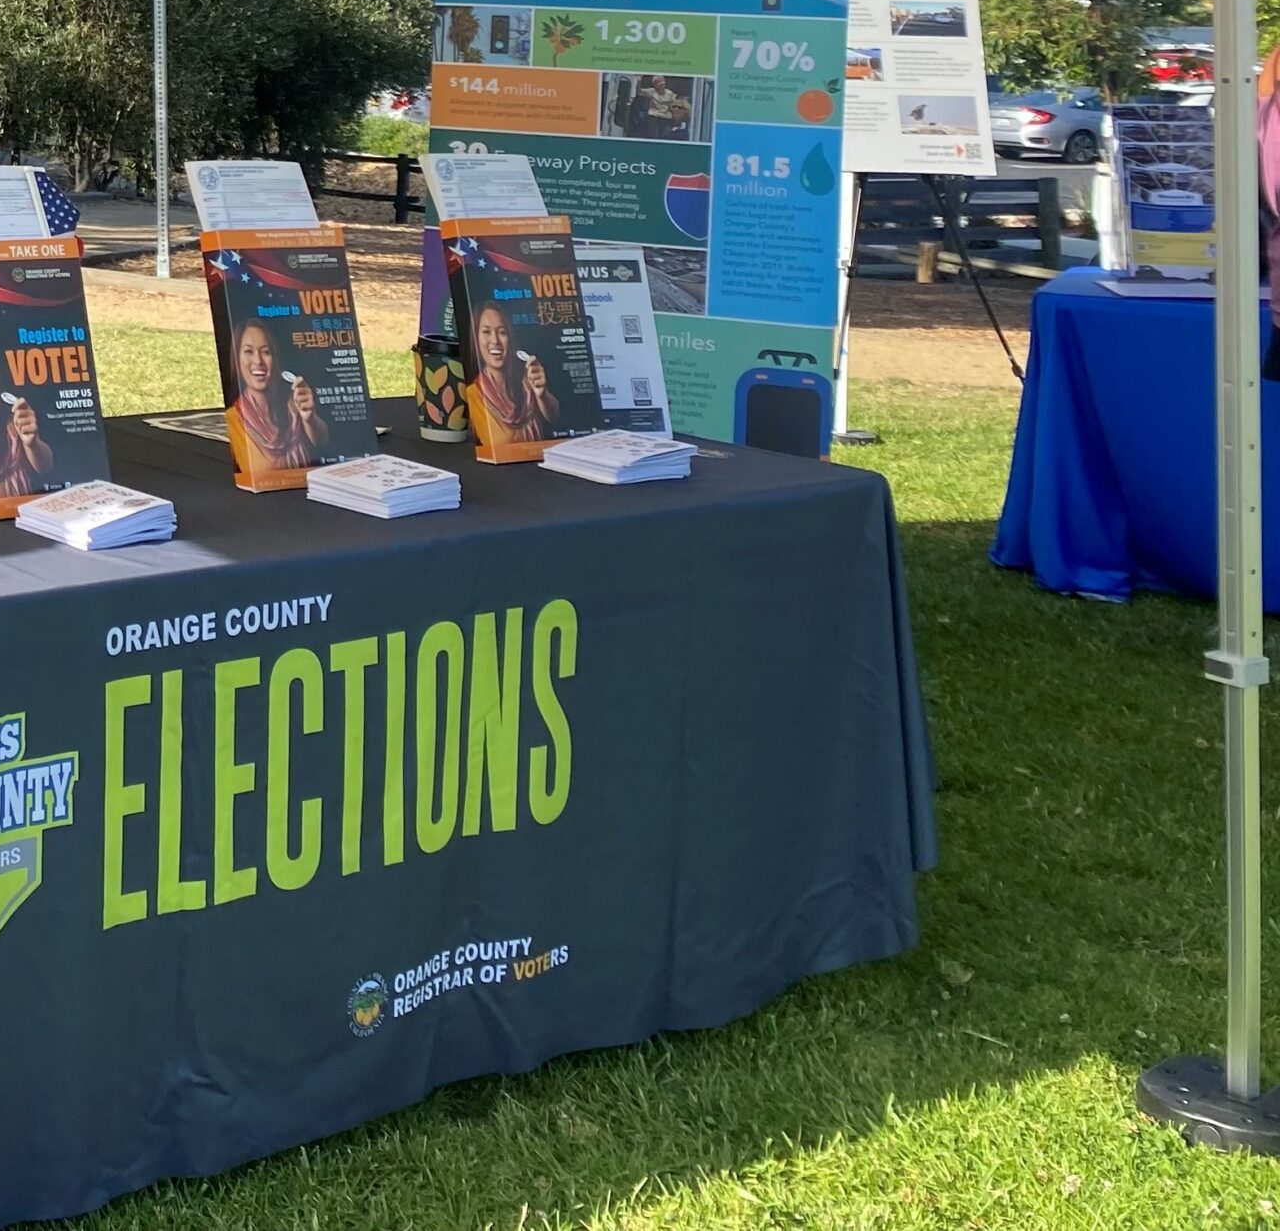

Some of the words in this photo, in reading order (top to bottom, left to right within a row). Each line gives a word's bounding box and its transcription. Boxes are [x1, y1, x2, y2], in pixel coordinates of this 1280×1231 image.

[595, 19, 687, 45] 1,300
[732, 39, 816, 72] 70%
[450, 76, 500, 95] $144
[503, 84, 558, 98] million
[578, 155, 657, 177] Projects
[727, 153, 791, 179] 81.5
[726, 181, 788, 198] million
[9, 245, 39, 257] TAKE
[41, 244, 66, 256] ONE
[591, 266, 609, 279] US
[493, 288, 525, 302] Register
[525, 287, 533, 299] to
[530, 273, 578, 298] VOTE!
[298, 288, 351, 315] VOTE!
[583, 292, 614, 303] cebook
[257, 304, 291, 318] Register
[292, 304, 300, 316] to
[537, 301, 582, 326] 投票!
[18, 327, 69, 345] Register
[72, 325, 86, 341] to
[291, 329, 356, 350] 투표합시다!
[560, 335, 585, 343] UPDATED
[659, 331, 716, 352] miles
[331, 356, 359, 366] UPDATED
[333, 349, 347, 357] KEEP
[348, 349, 358, 357] US
[4, 345, 91, 387] VOTE!
[55, 398, 94, 410] UPDATED
[59, 389, 79, 399] KEEP
[80, 388, 93, 398] US
[105, 611, 217, 656] ORANGE
[224, 593, 333, 637] COUNTY
[103, 598, 579, 931] ELECTIONS
[393, 950, 451, 994] ORANGE
[454, 936, 533, 966] COUNTY
[393, 967, 474, 1019] REGISTRAR
[479, 963, 507, 984] OF
[512, 944, 569, 981] VOTERS
